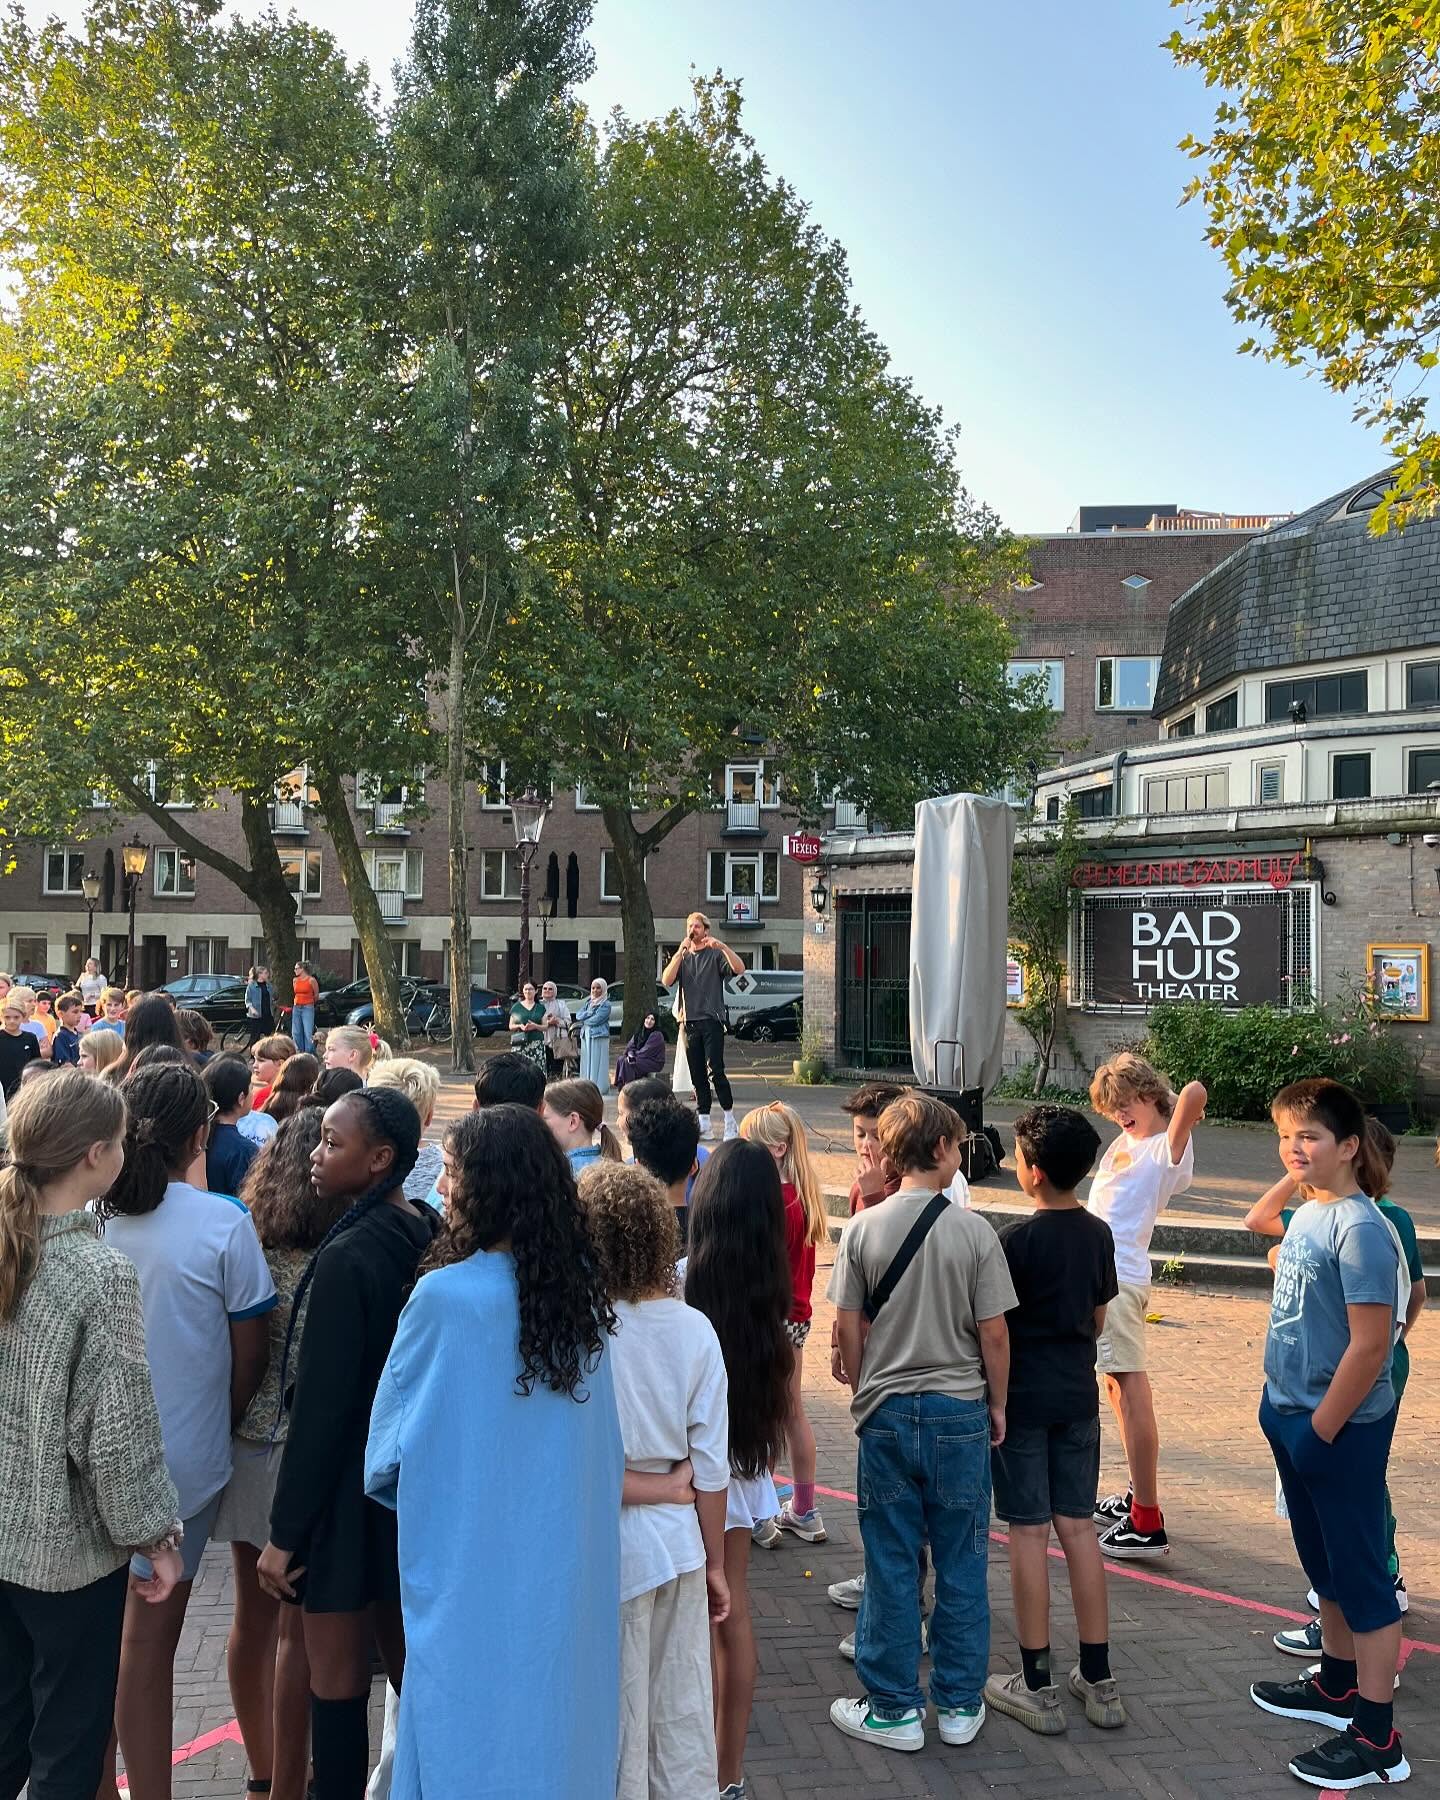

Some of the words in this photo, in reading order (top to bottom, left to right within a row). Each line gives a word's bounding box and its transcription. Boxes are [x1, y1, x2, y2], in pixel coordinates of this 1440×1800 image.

[790, 839, 818, 855] TEXELS
[1132, 911, 1241, 946] BAD
[1132, 948, 1241, 981] HUIS
[1132, 982, 1240, 1001] THEATER
